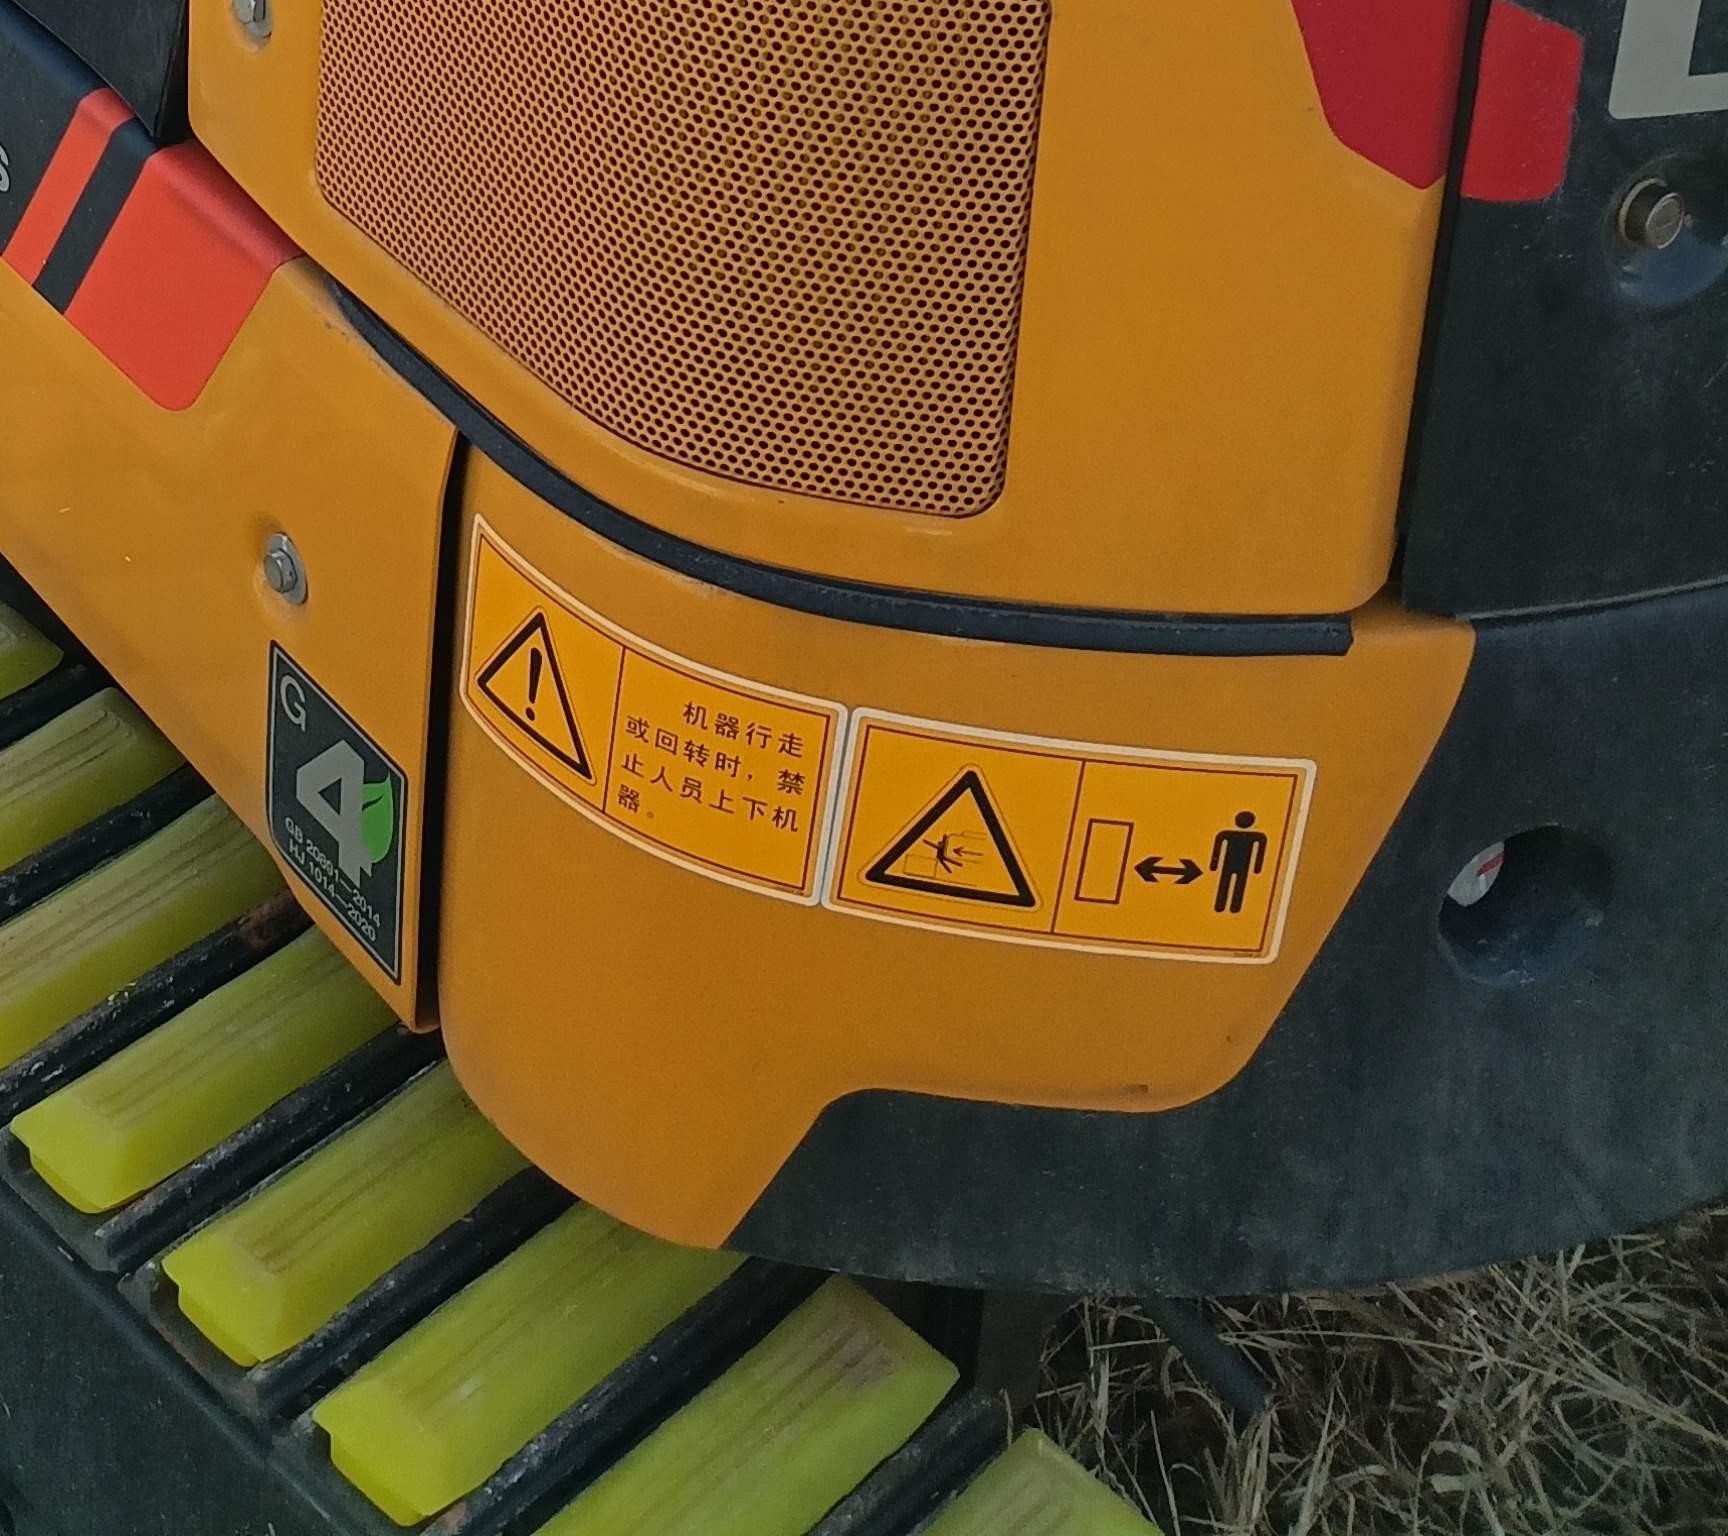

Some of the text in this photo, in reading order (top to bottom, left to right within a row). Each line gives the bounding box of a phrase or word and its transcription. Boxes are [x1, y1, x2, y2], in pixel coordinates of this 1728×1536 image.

[682, 701, 804, 758] 机器行走
[621, 753, 798, 832] 止人员上下机
[289, 839, 305, 865] HJ
